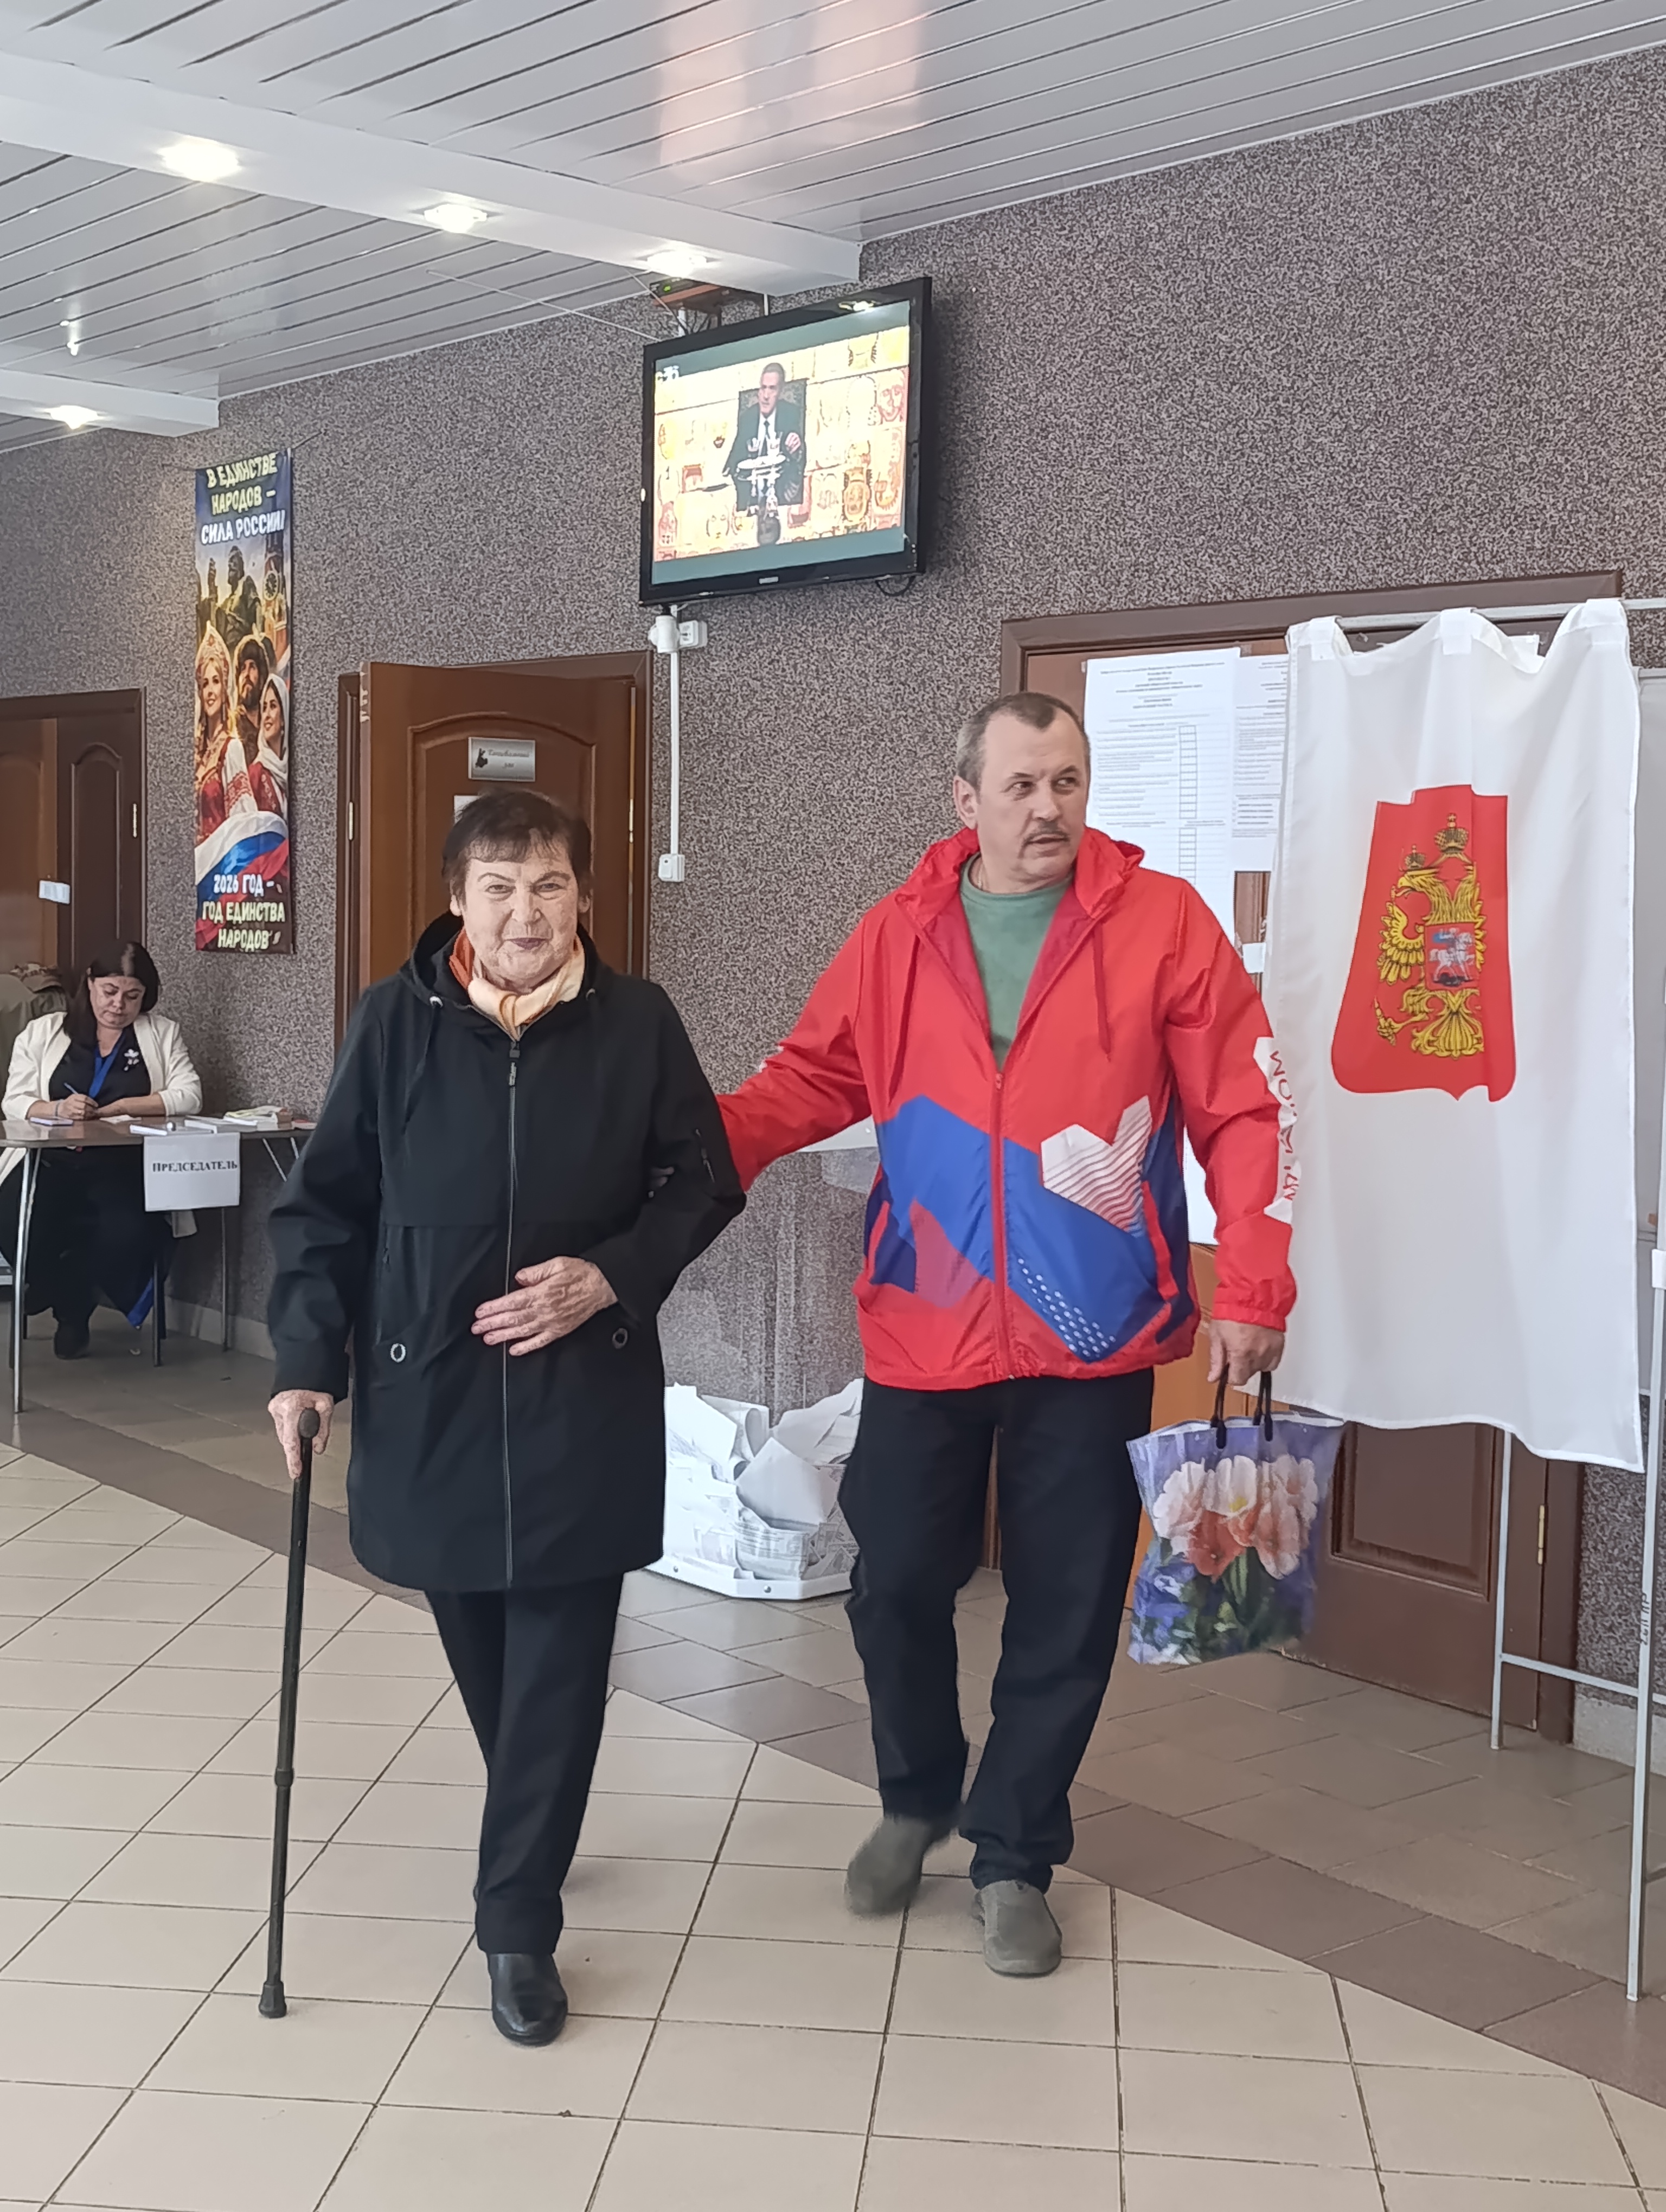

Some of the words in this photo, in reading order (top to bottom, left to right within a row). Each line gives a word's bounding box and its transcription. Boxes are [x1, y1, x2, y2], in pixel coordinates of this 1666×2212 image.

[206, 468, 217, 488] В
[217, 451, 278, 488] ЕДИНСТВЕ
[212, 485, 262, 515] НАРОДОВ
[201, 520, 234, 544] СИЛА
[235, 510, 285, 539] РОССИИ
[213, 873, 239, 893] 2026
[242, 873, 264, 897] ГОД
[202, 901, 224, 924] ГОД
[226, 902, 286, 924] ЕДИНСТВА
[217, 928, 270, 953] НАРОДОВ
[152, 1161, 238, 1173] ПРЕДСЕДАТЕЛЬ
